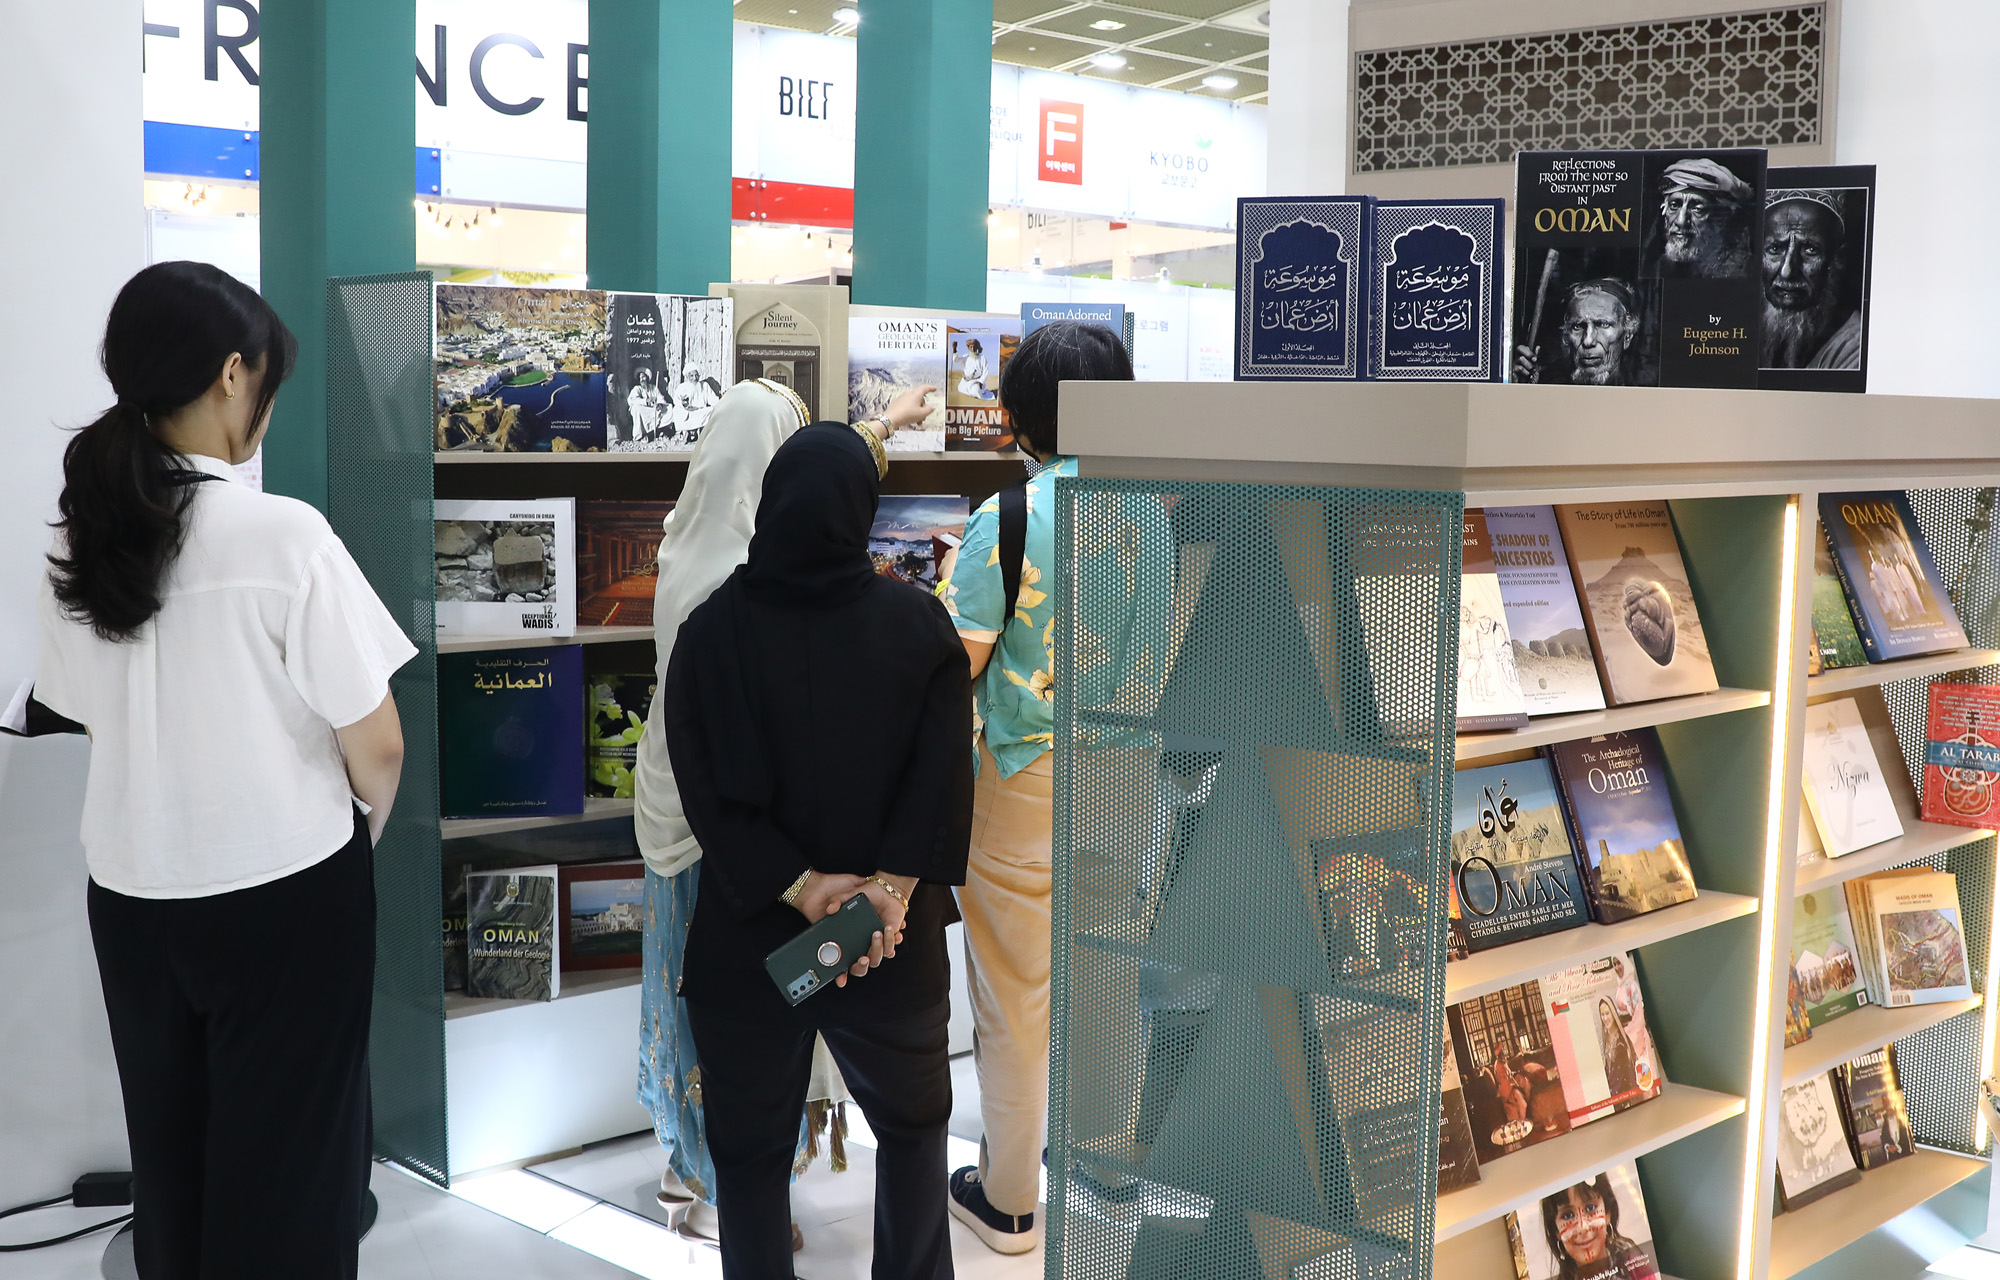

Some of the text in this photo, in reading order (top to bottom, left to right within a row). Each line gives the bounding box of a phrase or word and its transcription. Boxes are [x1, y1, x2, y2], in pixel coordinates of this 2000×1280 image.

[779, 76, 834, 120] BIEF
[1046, 111, 1078, 156] F
[1045, 160, 1076, 174] 어학센터
[1149, 150, 1209, 173] KYOBO
[1552, 158, 1616, 172] REFLECTIONS
[1539, 172, 1568, 185] FROM
[1592, 172, 1613, 182] NOT
[1615, 172, 1629, 181] SO
[1550, 183, 1617, 197] DISTANT PAST
[1577, 197, 1588, 205] IN
[1534, 207, 1632, 233] OMAN
[767, 311, 793, 322] Silent
[1032, 308, 1112, 320] Oman Adorned
[1709, 314, 1721, 326] by
[762, 318, 798, 330] Journey
[878, 321, 938, 333] OMAN'S
[878, 333, 938, 341] GEOLOGICAL
[1683, 327, 1747, 342] Eugene H.
[878, 341, 938, 350] HERITAGE
[1688, 343, 1740, 357] Johnson
[959, 425, 971, 436] Big
[974, 425, 1002, 435] Picture
[1575, 508, 1666, 522] The Story of Life in Oman
[1842, 502, 1902, 525] OMAN
[1496, 534, 1550, 547] SHADOW OF
[1493, 551, 1555, 566] ANCESTORS
[522, 619, 553, 629] WADIS
[474, 672, 552, 695] العمانية
[1582, 753, 1596, 763] The
[1608, 754, 1643, 769] Heritage of
[1940, 747, 2000, 762] AL TARAB
[1588, 767, 1650, 794] Oman
[1827, 761, 1869, 800] Nizwa
[1524, 859, 1564, 873] André Stevens
[1458, 856, 1571, 916] OMAN
[1469, 900, 1575, 931] CITADELLES ENTRE SABLE ET MER
[1471, 908, 1577, 939] CITADELS BETWEEN SAND AND SEA
[483, 929, 540, 944] OMAN
[473, 948, 550, 961] Wunderland der Geologie
[1852, 1051, 1887, 1069] Oman
